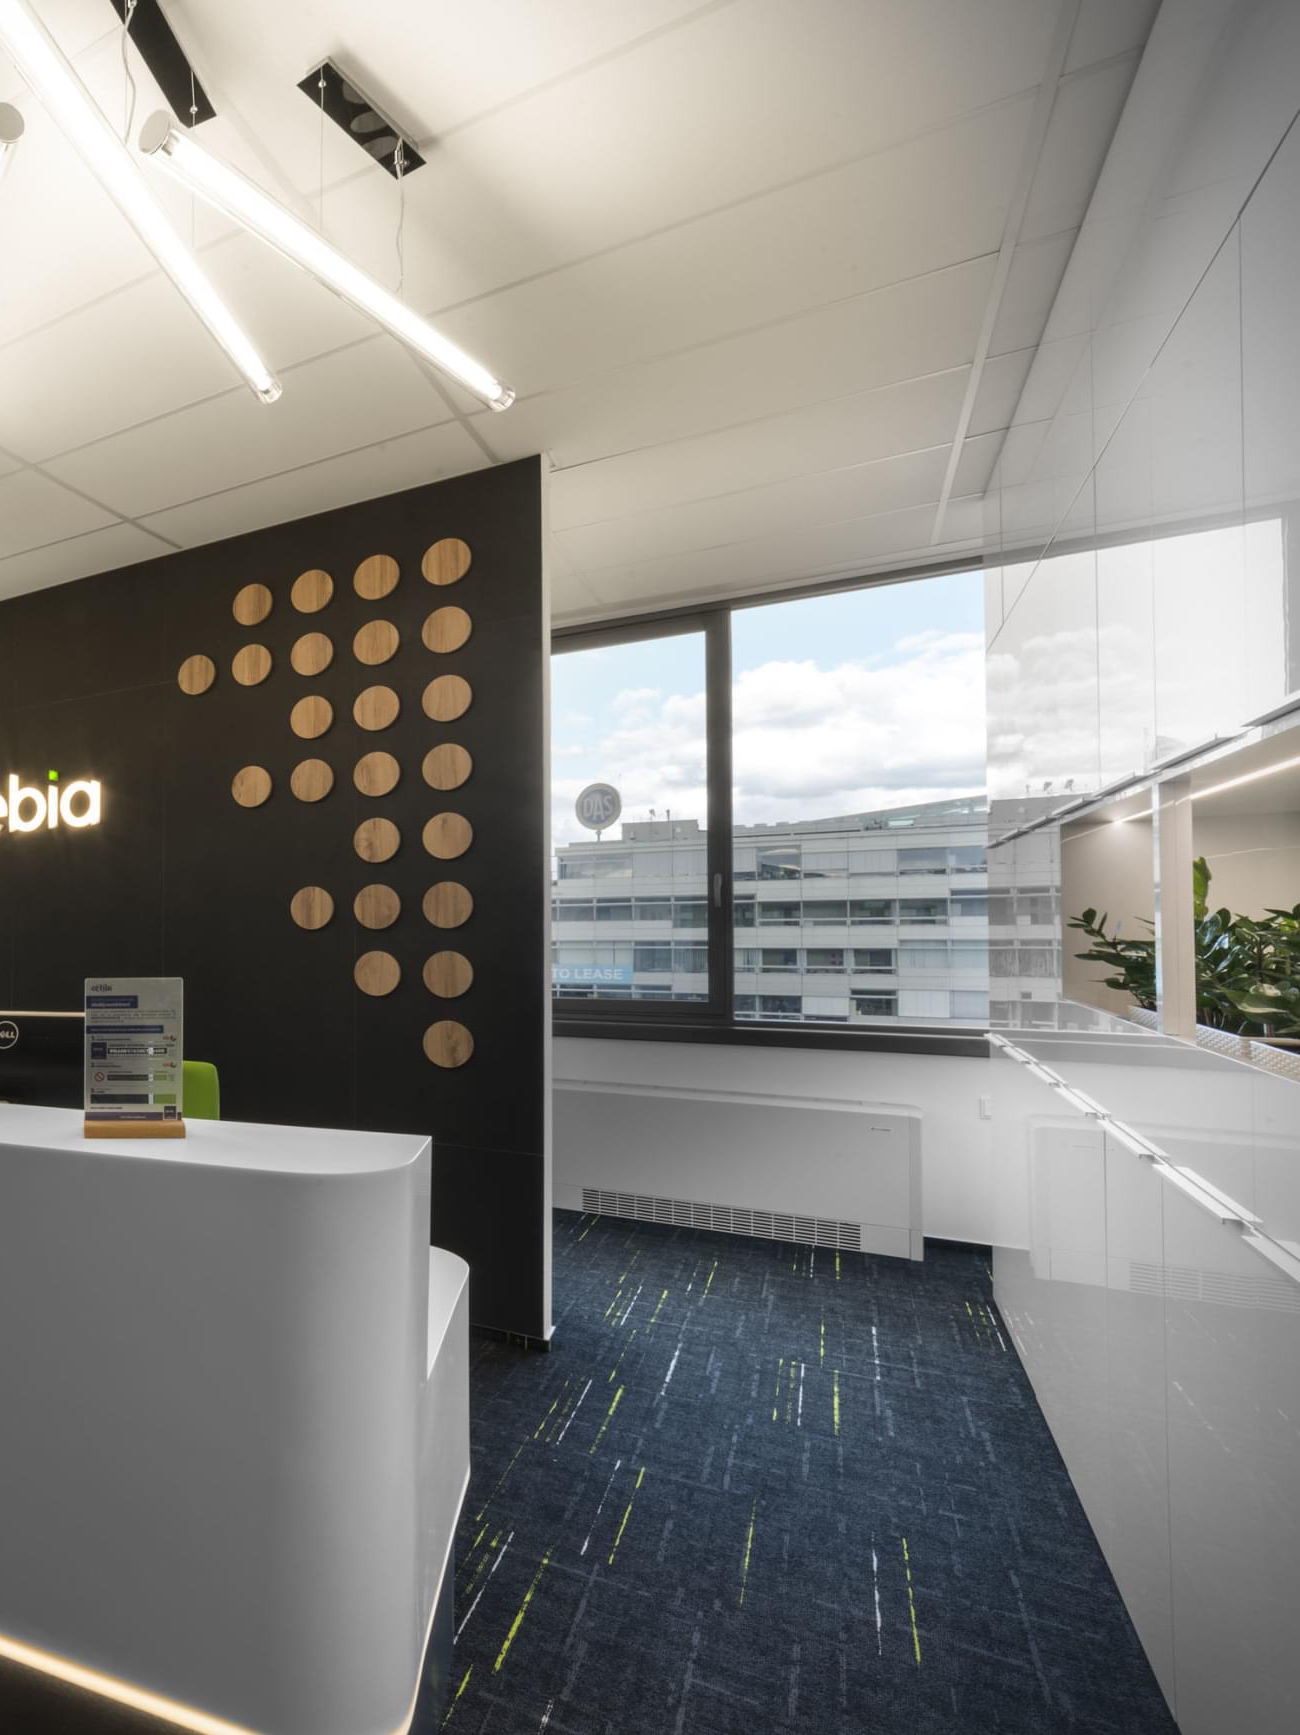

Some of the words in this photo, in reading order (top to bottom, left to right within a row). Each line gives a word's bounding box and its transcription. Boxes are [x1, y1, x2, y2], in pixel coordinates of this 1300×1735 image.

[583, 794, 613, 820] DAS
[552, 968, 570, 979] TO
[574, 968, 624, 980] LEASE
